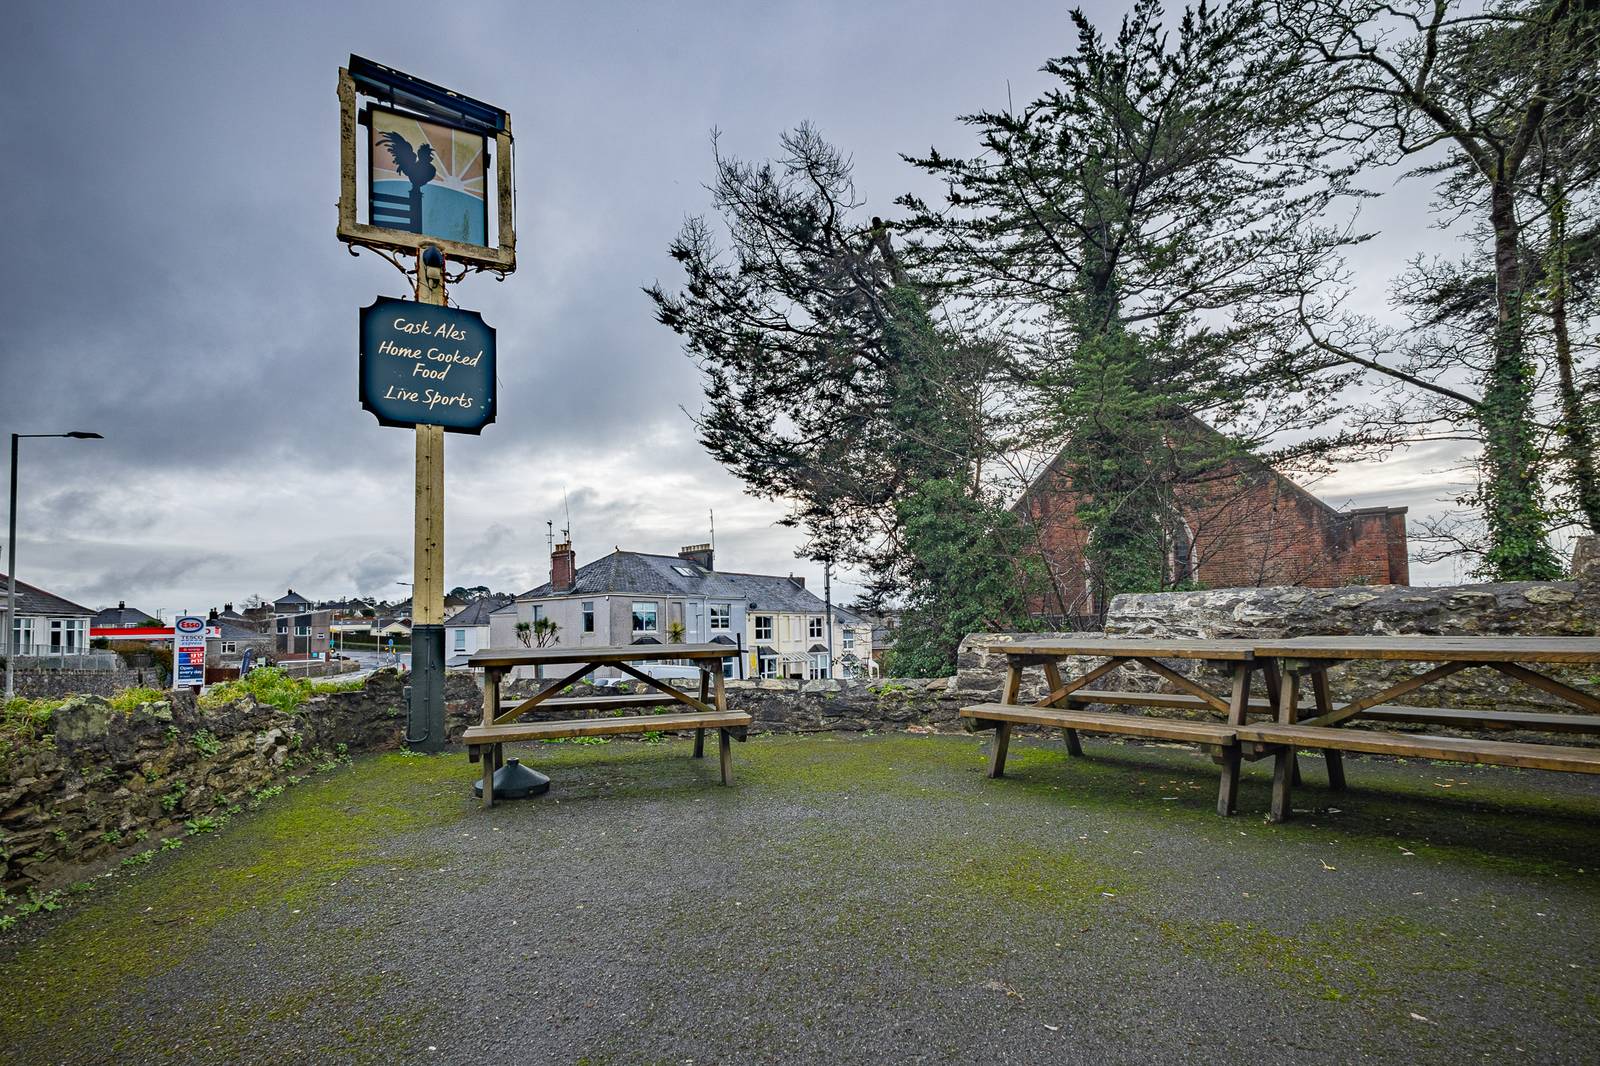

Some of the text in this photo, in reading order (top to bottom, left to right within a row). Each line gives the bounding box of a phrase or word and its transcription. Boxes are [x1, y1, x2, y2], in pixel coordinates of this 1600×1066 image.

[394, 318, 467, 341] Cask Ales
[378, 340, 483, 367] Home Cooked
[412, 362, 452, 381] Food
[383, 385, 473, 410] Live Sports
